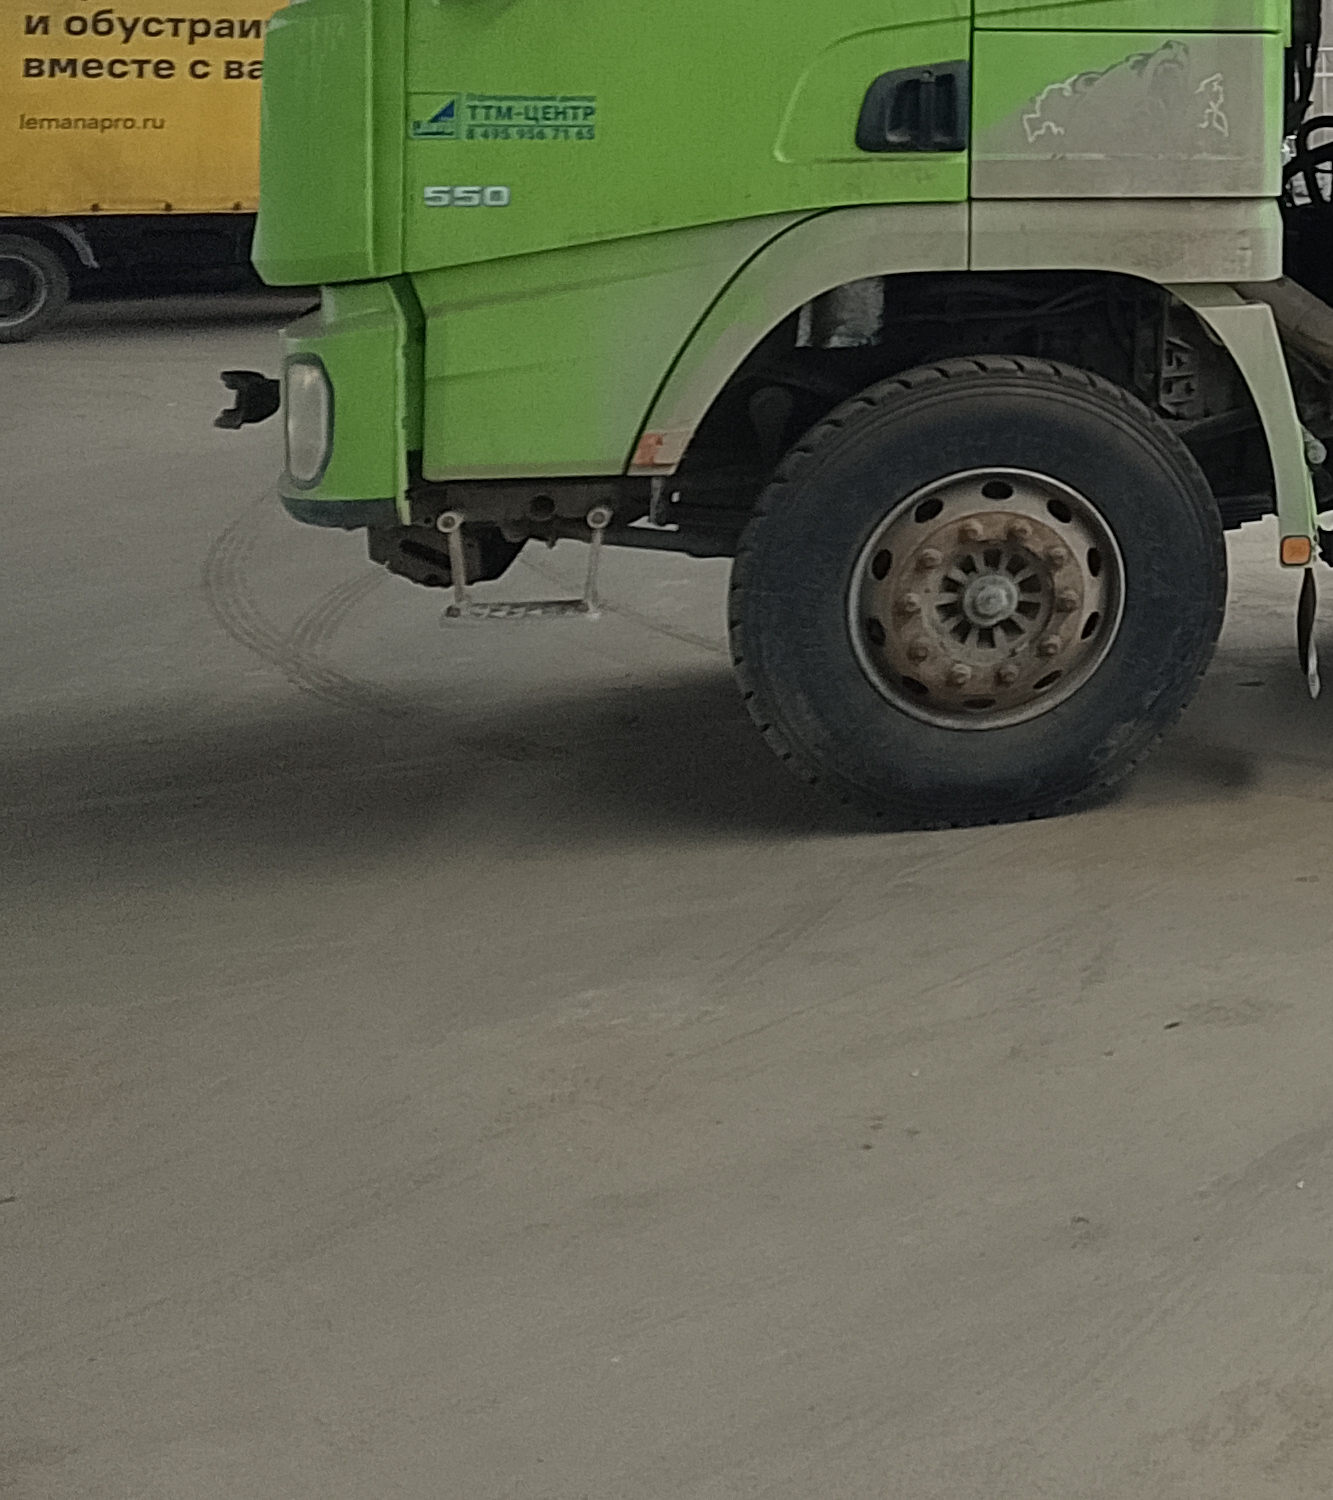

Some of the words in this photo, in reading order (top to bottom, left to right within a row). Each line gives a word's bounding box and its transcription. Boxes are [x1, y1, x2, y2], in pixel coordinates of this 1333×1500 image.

[24, 14, 50, 36] и
[64, 8, 271, 45] обустраи
[22, 57, 176, 79] вместе
[189, 59, 210, 79] с
[19, 113, 165, 133] lemanapro.ru
[466, 104, 596, 123] ТТМ-ЦЕНТР
[423, 185, 511, 207] 550
